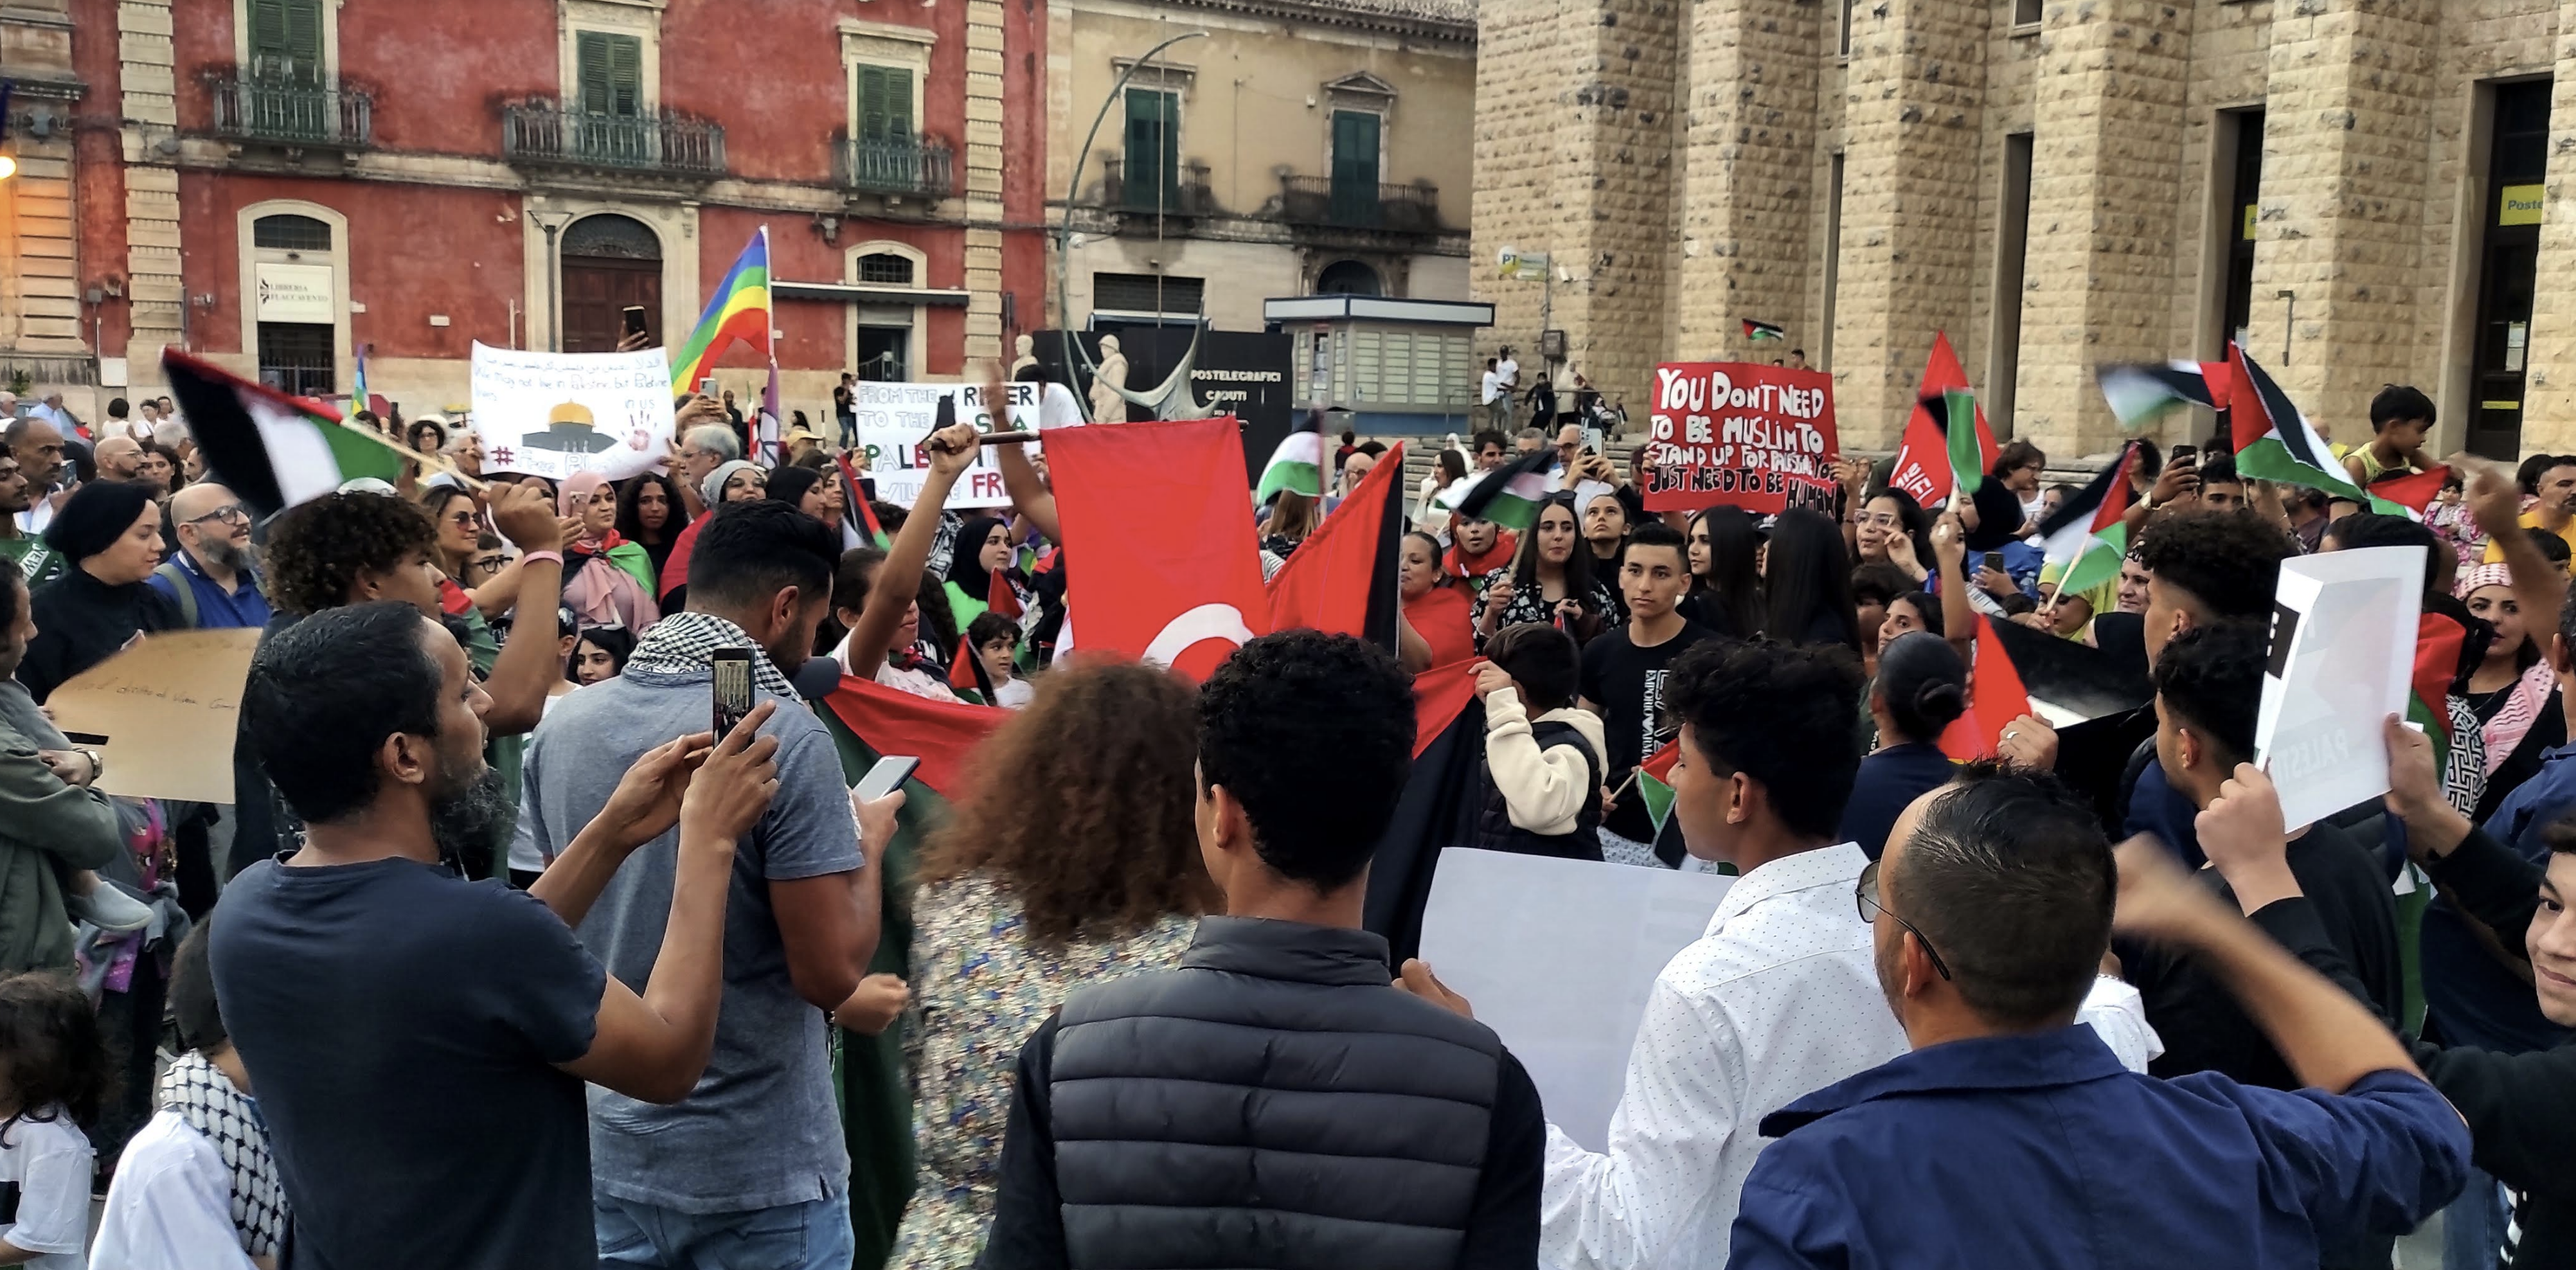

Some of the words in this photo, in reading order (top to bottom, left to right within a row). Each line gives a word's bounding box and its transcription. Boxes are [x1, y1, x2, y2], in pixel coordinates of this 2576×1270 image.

[1503, 253, 1517, 265] PT
[1190, 369, 1282, 382] POSTELEGRAFICI
[859, 386, 902, 404] FROM
[905, 388, 938, 404] THE
[964, 385, 1035, 406] RIER
[1657, 368, 1706, 412] YOU
[1778, 384, 1825, 419] NEED
[859, 410, 888, 428] TO
[895, 411, 931, 429] THE
[974, 413, 1029, 435] SA
[1650, 413, 1674, 441] TO
[1685, 414, 1714, 444] BE
[1795, 422, 1825, 454] TO
[1645, 440, 1707, 466] STAND
[1711, 445, 1735, 466] UP
[1741, 445, 1770, 469] FOR
[1649, 467, 1690, 494] JUST
[1690, 467, 1737, 494] NEED
[1735, 467, 1762, 493] TO
[1765, 472, 1785, 494] BE
[1786, 478, 1836, 521] HUMAN
[25, 551, 44, 573] NEW
